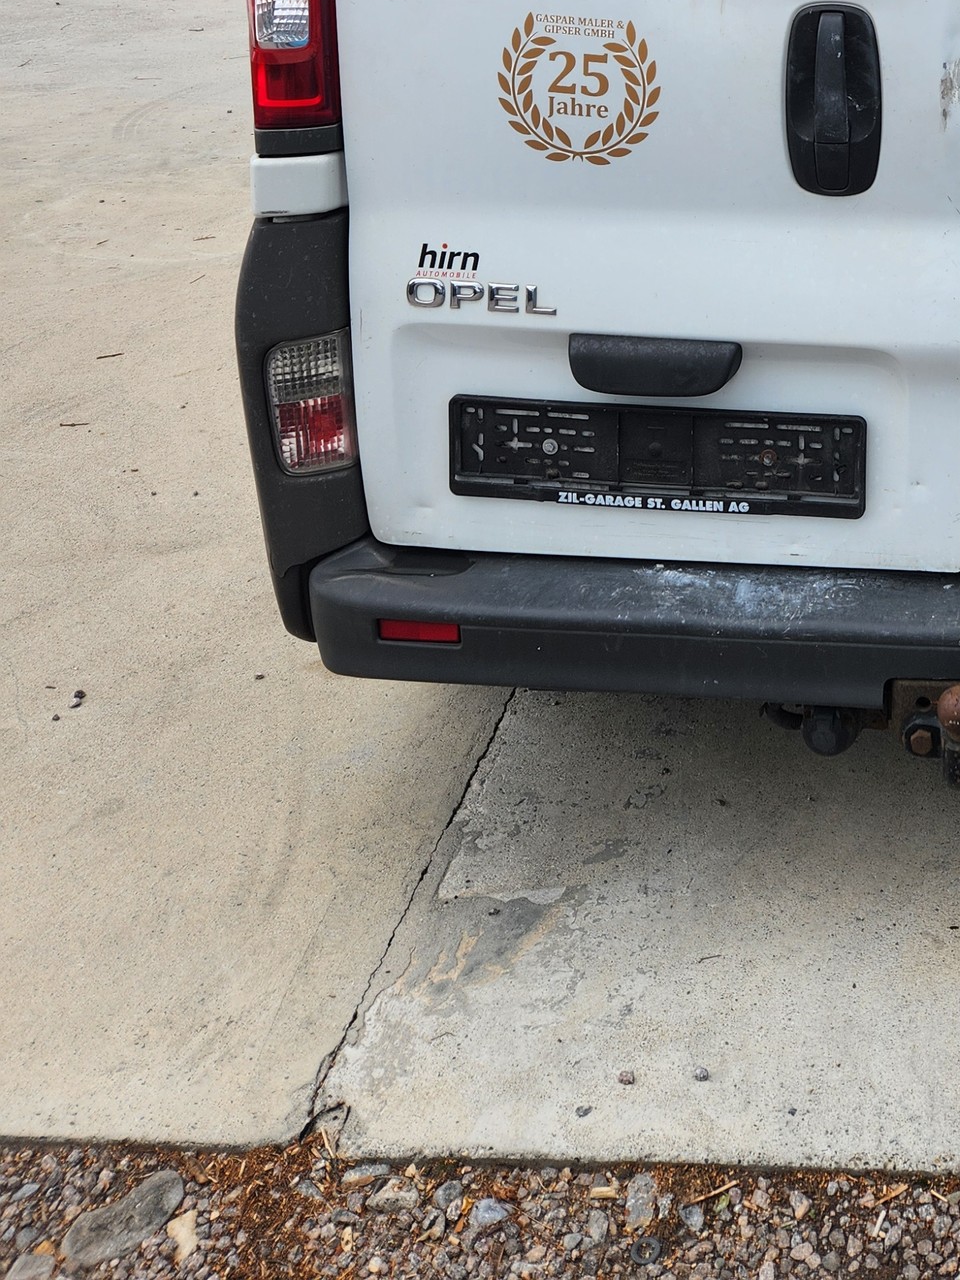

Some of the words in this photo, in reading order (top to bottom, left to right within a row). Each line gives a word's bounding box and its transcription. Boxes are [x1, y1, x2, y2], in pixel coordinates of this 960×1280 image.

[535, 13, 575, 25] GASPAR
[578, 17, 614, 29] MALER
[616, 21, 625, 29] &
[544, 24, 581, 36] GIPSER
[583, 28, 615, 39] GMBH
[547, 51, 609, 97] 25
[547, 96, 609, 119] Jahre
[418, 243, 480, 271] hirn
[416, 270, 477, 279] AUTOMOBILE
[406, 277, 557, 316] OPEL
[558, 492, 643, 508] ZIL-GARAGE
[647, 498, 666, 510] ST.
[671, 499, 724, 512] GALLEN
[728, 501, 750, 513] AG
